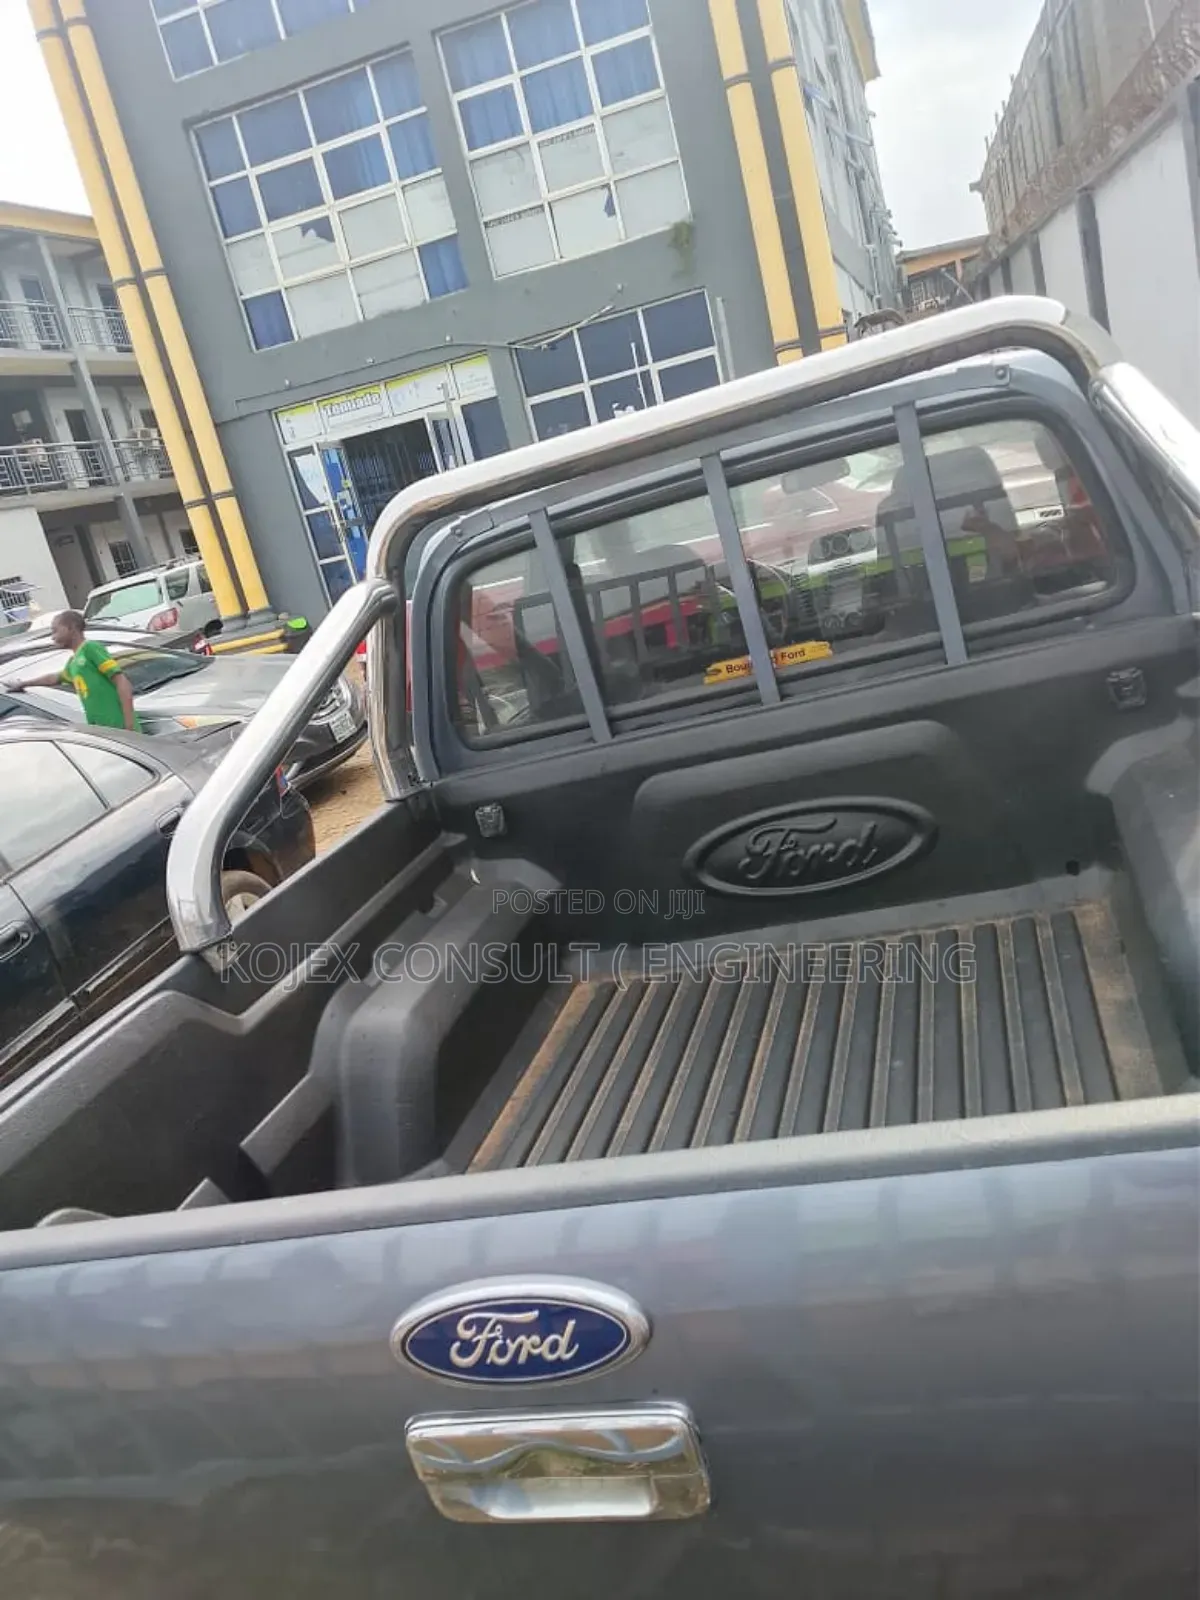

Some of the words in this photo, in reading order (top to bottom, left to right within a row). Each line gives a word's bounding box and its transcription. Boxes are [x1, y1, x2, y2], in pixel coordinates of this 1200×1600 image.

[780, 648, 806, 660] Ford
[738, 817, 878, 879] Ford
[449, 1310, 580, 1369] Ford
